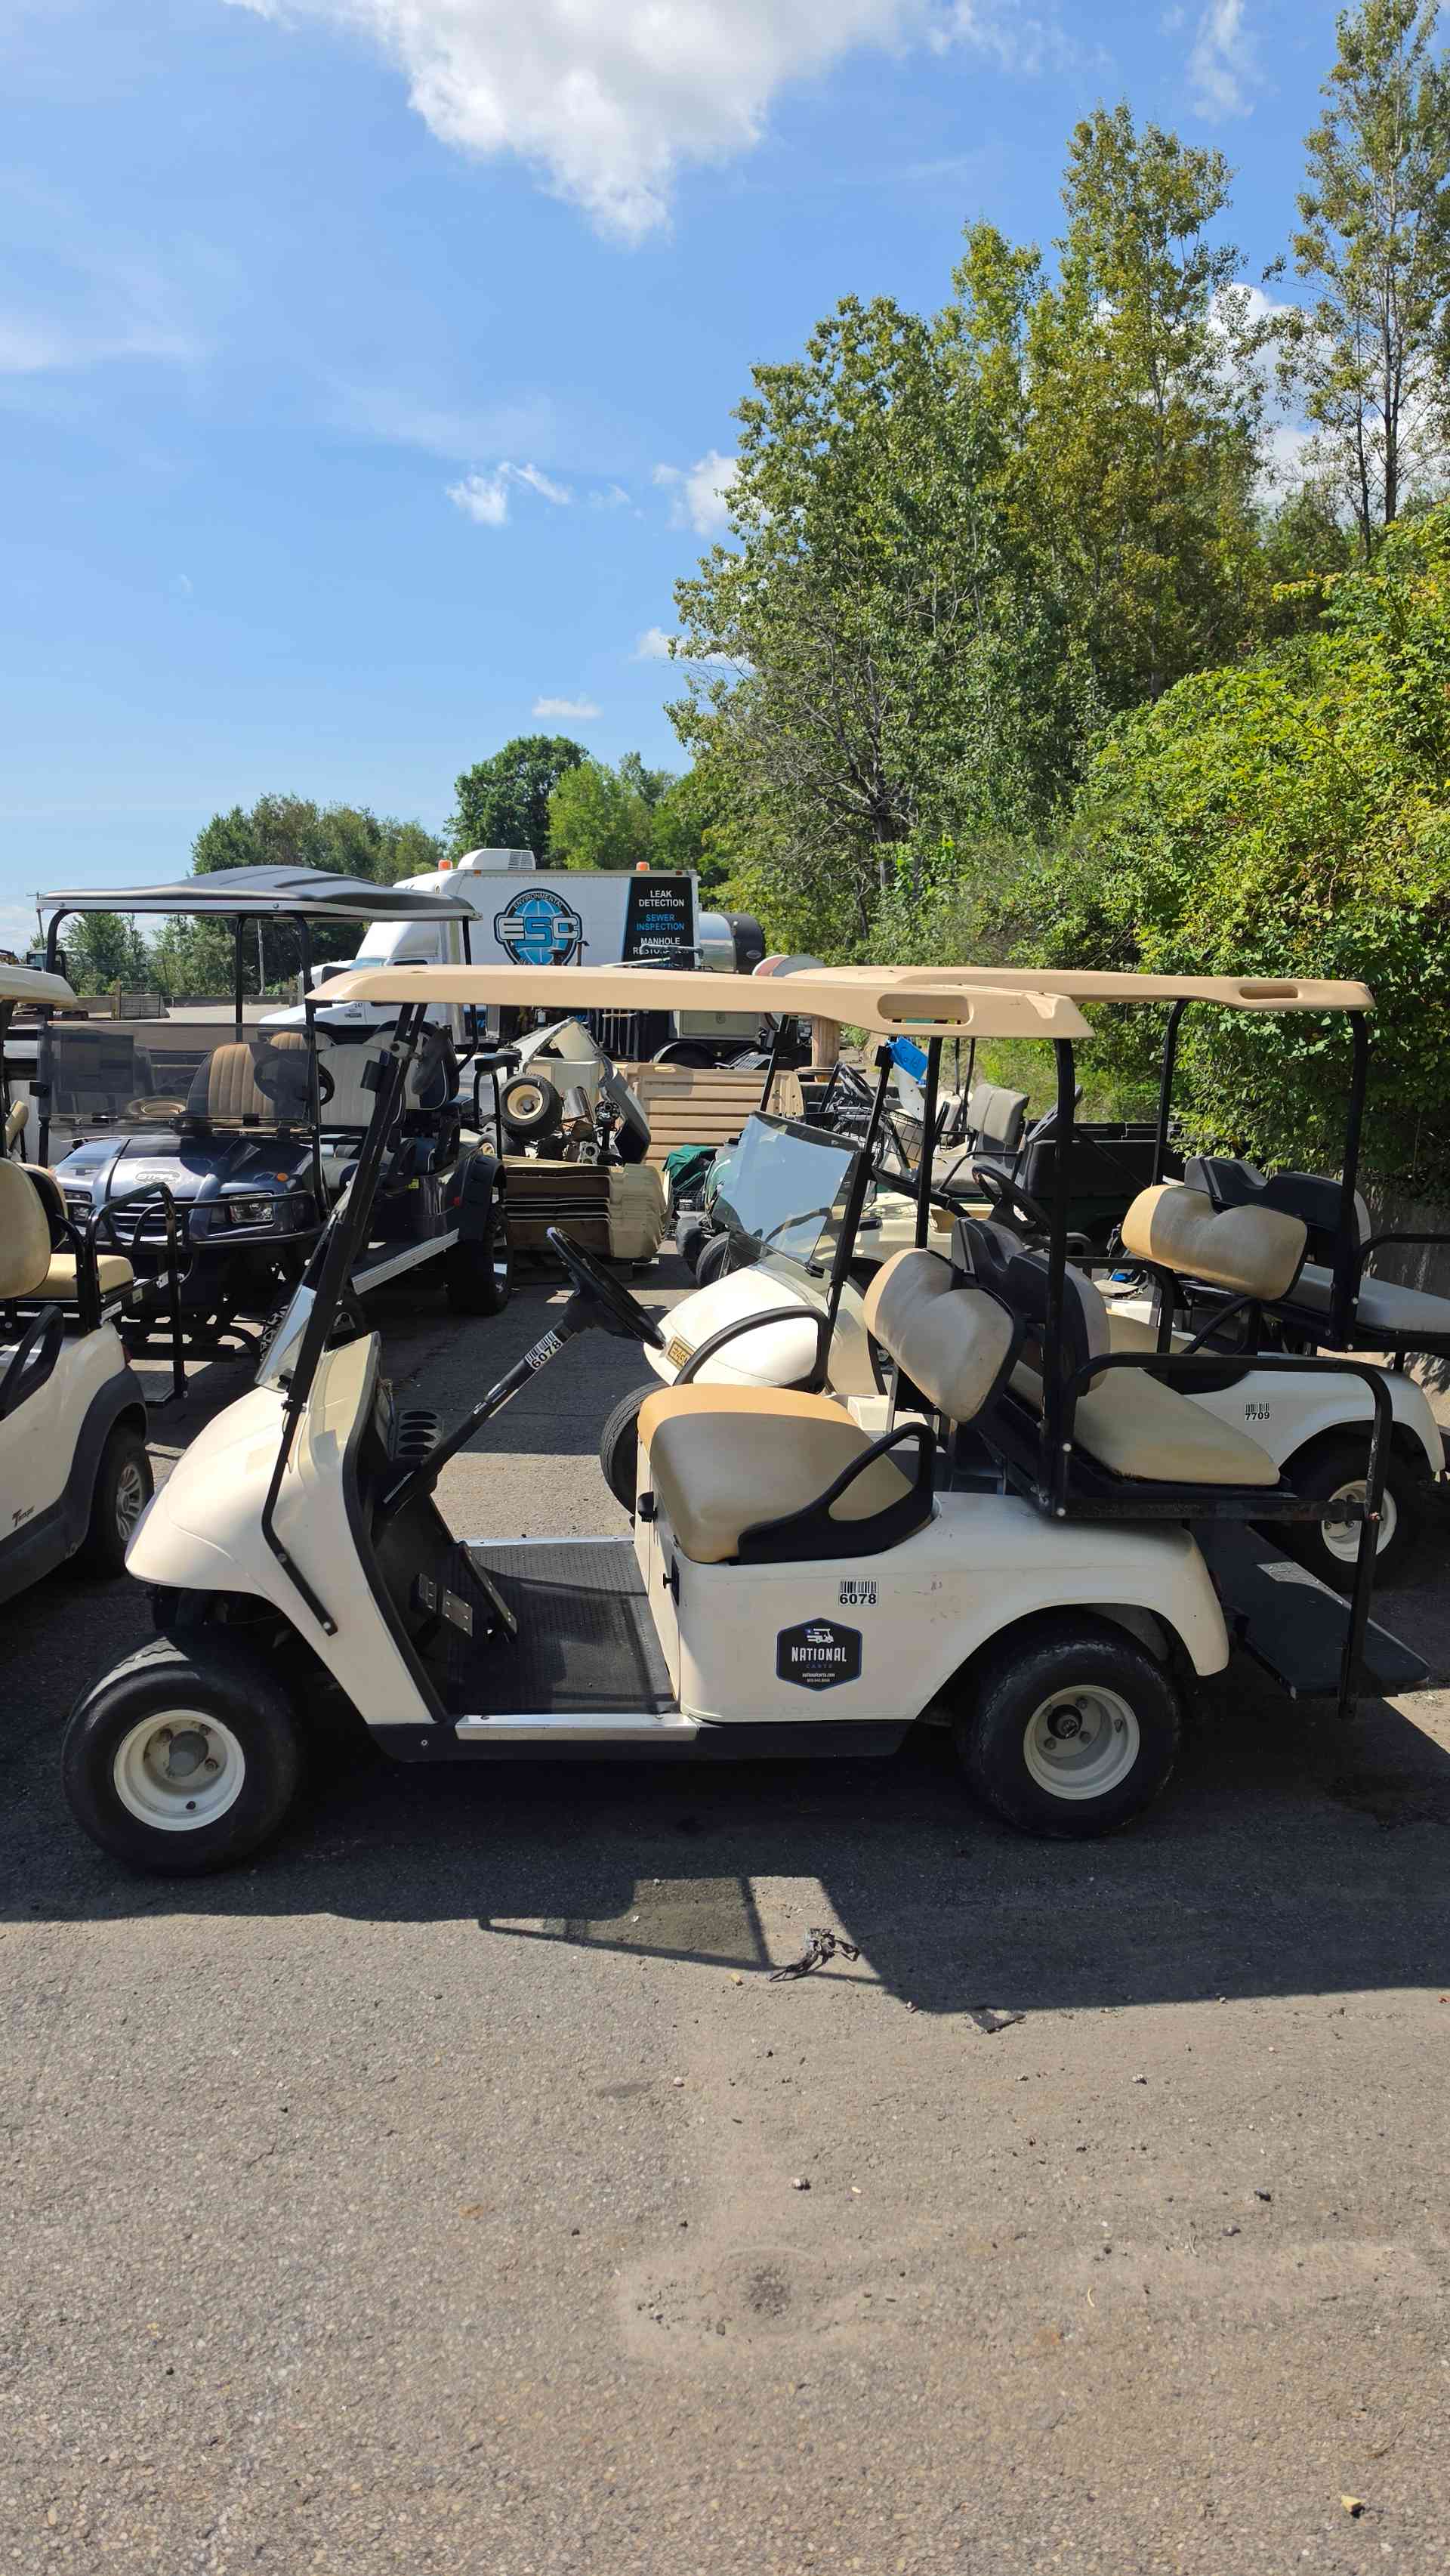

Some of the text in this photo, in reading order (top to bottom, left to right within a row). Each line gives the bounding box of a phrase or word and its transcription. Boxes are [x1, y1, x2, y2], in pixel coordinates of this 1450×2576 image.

[649, 890, 672, 898] LEAK
[638, 899, 684, 907] DETECTION
[498, 916, 578, 947] ESC
[637, 922, 684, 931] INSPECTION
[532, 1340, 561, 1368] 6078
[1245, 1412, 1270, 1421] 7709
[840, 1593, 877, 1605] 6078
[791, 1646, 847, 1662] NATIONAL
